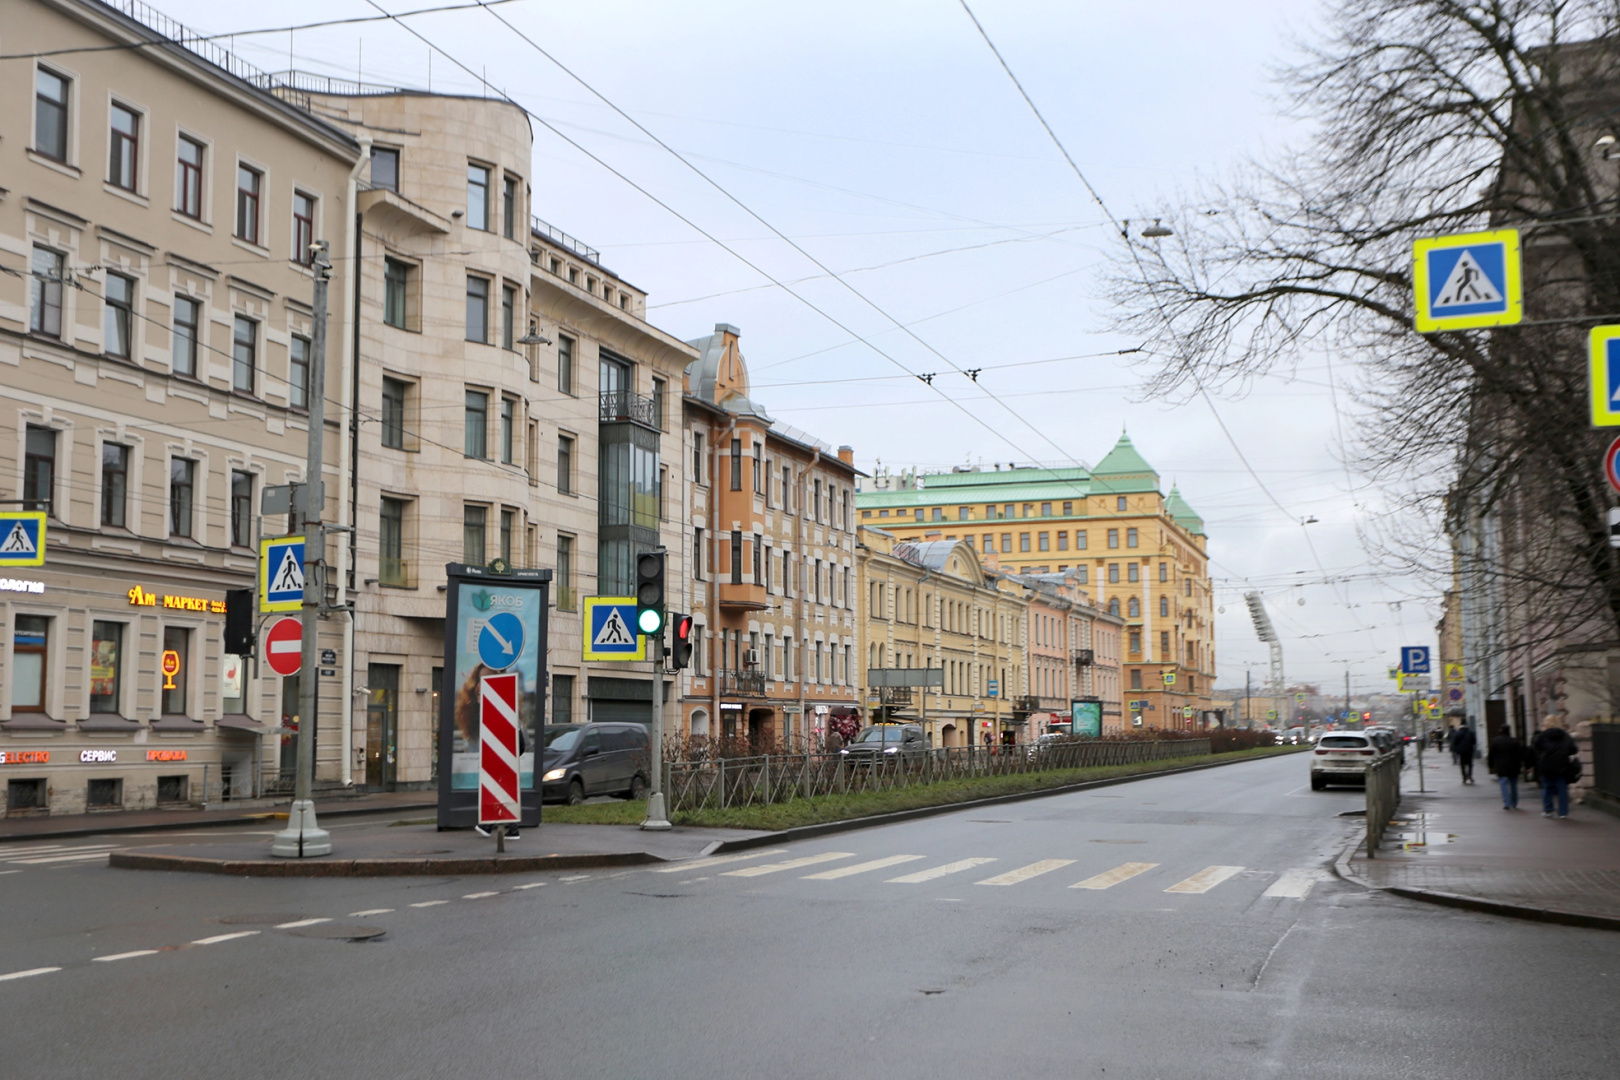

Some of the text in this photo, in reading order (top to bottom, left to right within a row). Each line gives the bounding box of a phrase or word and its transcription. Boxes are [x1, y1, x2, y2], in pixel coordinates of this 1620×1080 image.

[163, 595, 208, 611] МАРКЕТ
[490, 595, 523, 606] ЯКОБ
[80, 750, 117, 762] СЕРВИС
[146, 750, 188, 761] ПРОДАЖА
